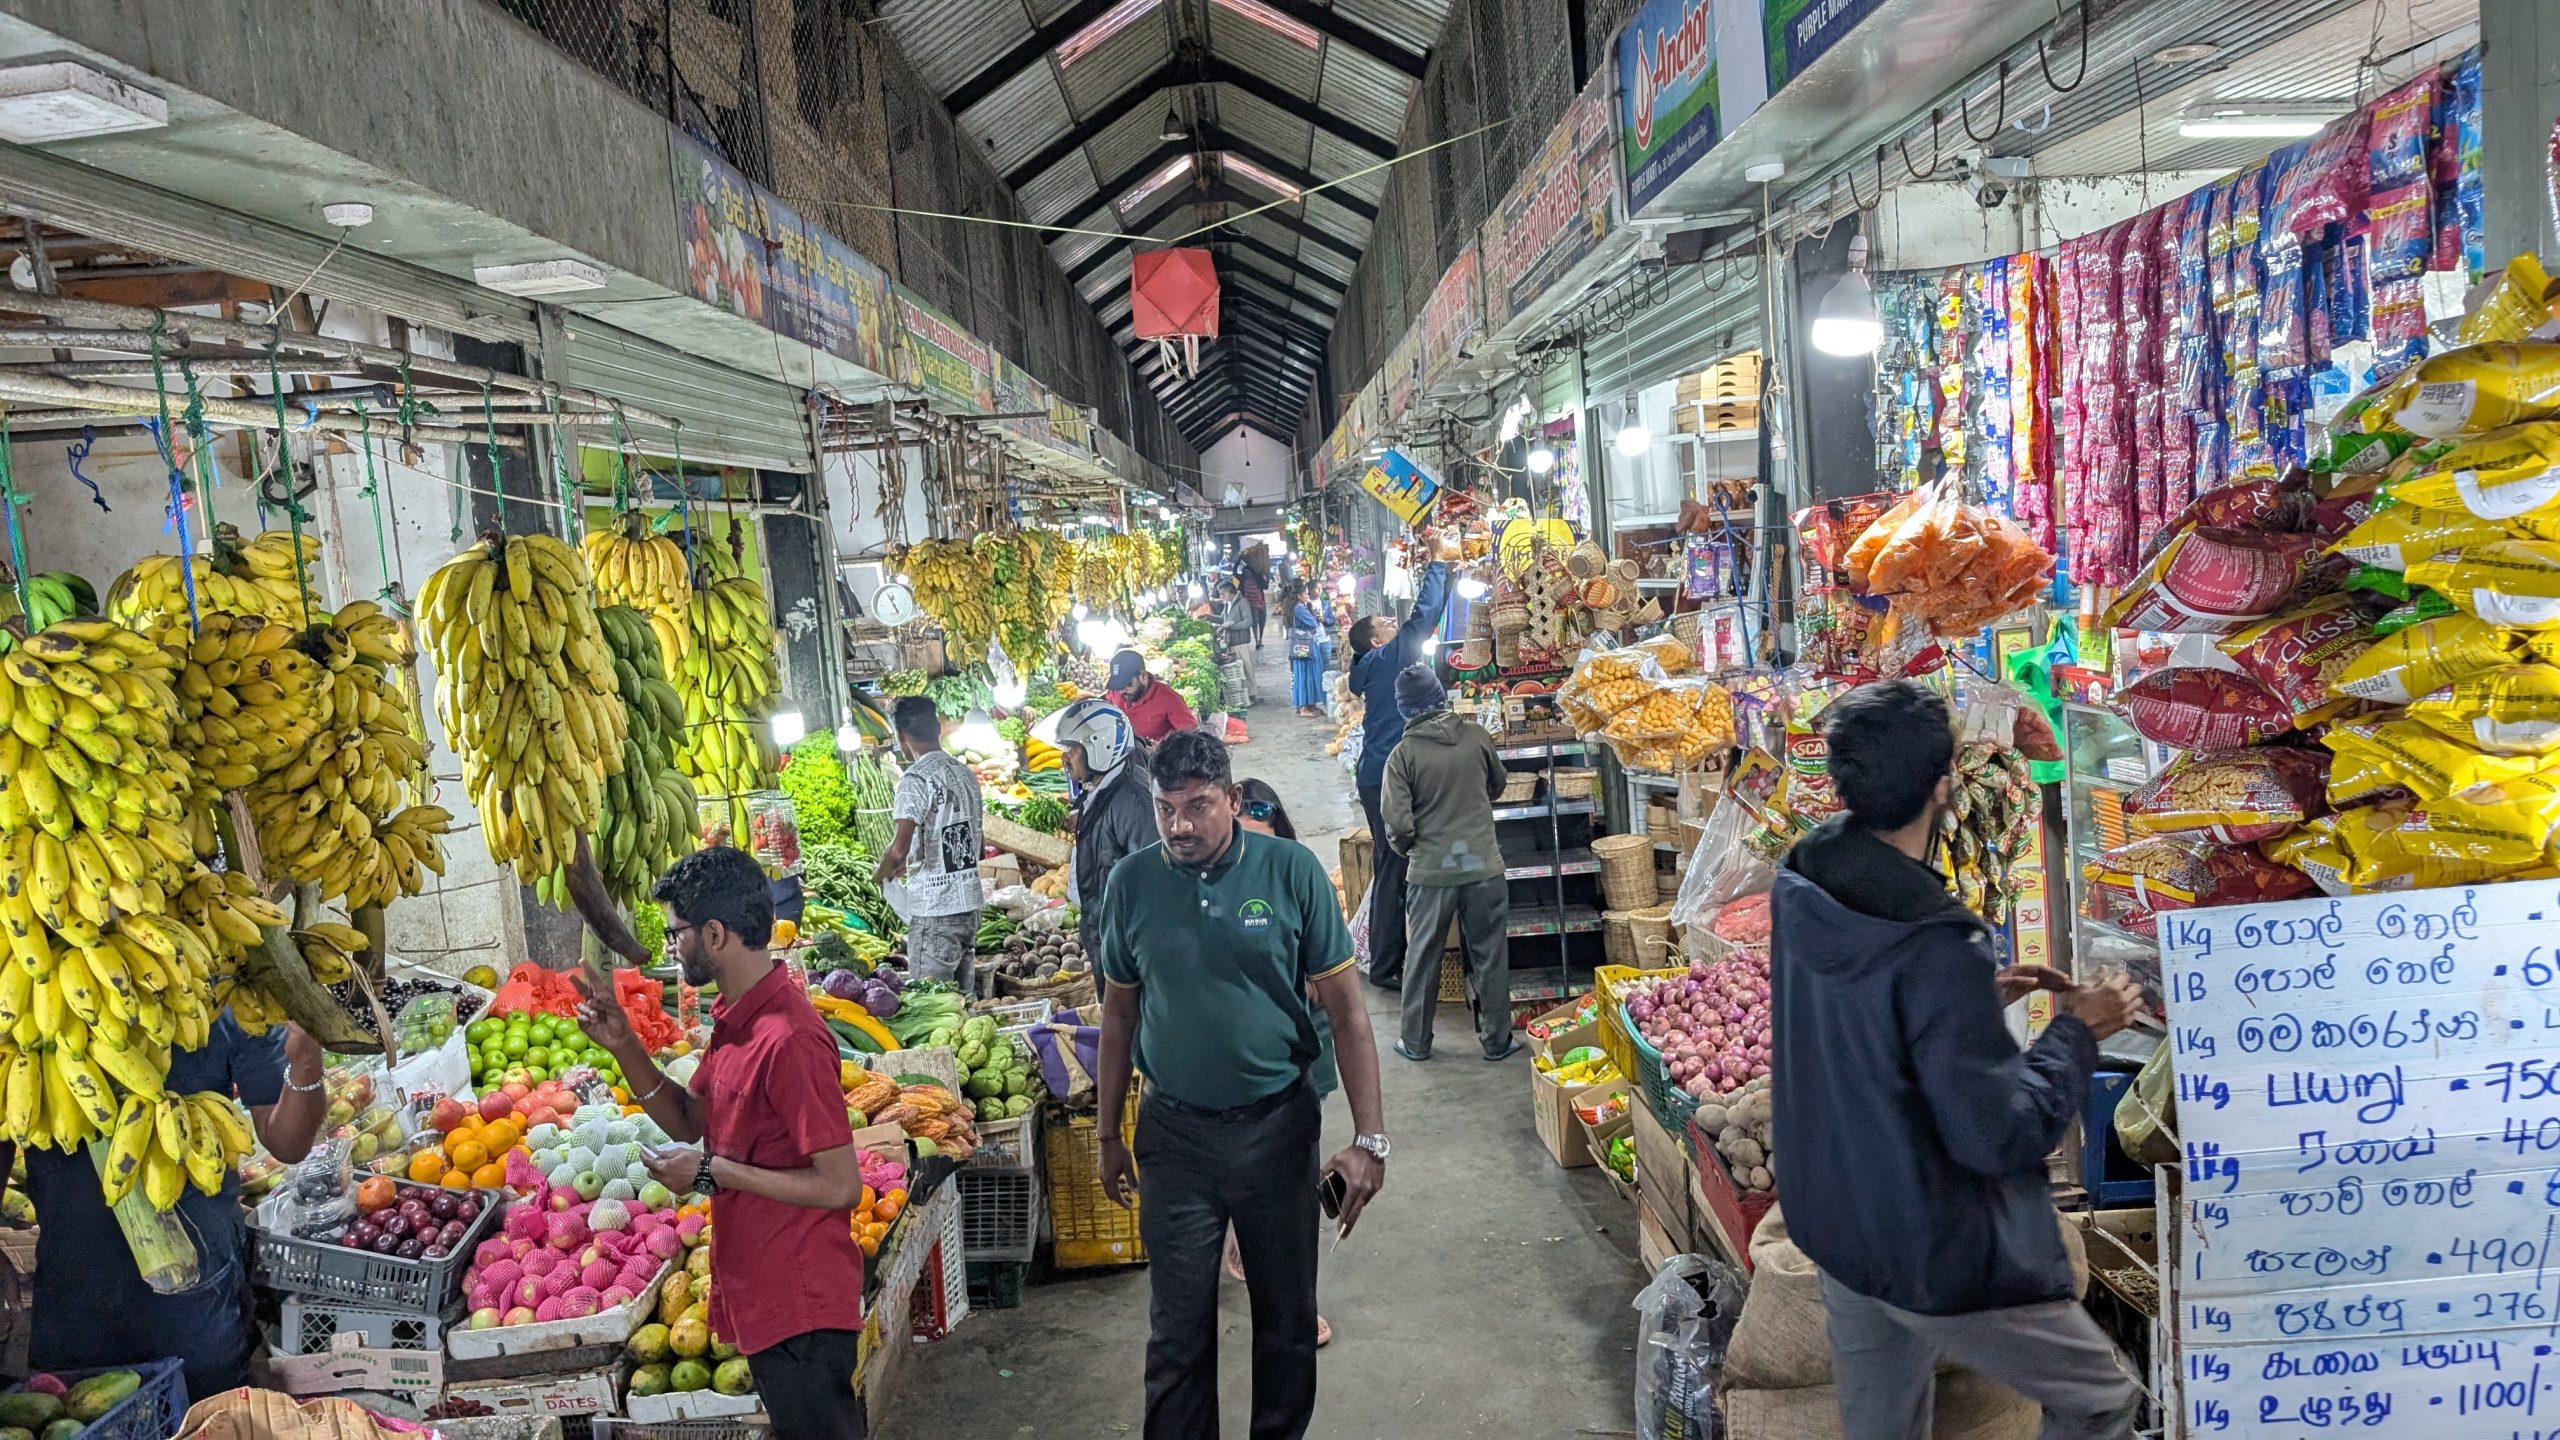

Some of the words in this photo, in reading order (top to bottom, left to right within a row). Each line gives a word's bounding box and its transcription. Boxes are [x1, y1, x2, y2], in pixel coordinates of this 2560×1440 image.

[1797, 2, 1827, 47] PURPLE
[1828, 0, 1853, 20] MAR
[1652, 0, 1709, 99] Anchor
[2167, 916, 2211, 959] 1Kg
[2235, 900, 2344, 949] පොල්
[2376, 889, 2479, 941] තෙල්
[2174, 971, 2207, 1003] 1B
[2234, 953, 2337, 995] පොල්
[2366, 943, 2455, 986] තෙල්
[2177, 1026, 2216, 1059] 1Kg
[2180, 1073, 2230, 1109] 1Kg
[2267, 1065, 2404, 1124] பயறு
[2187, 1141, 2239, 1193] 1Kg
[2383, 1168, 2477, 1208] තෙල්
[2192, 1200, 2229, 1228] 1Kg
[2192, 1305, 2231, 1333] 1Kg
[2192, 1354, 2230, 1381] 1Kg
[546, 1396, 598, 1410] DATES
[2195, 1399, 2229, 1429] 1Kg
